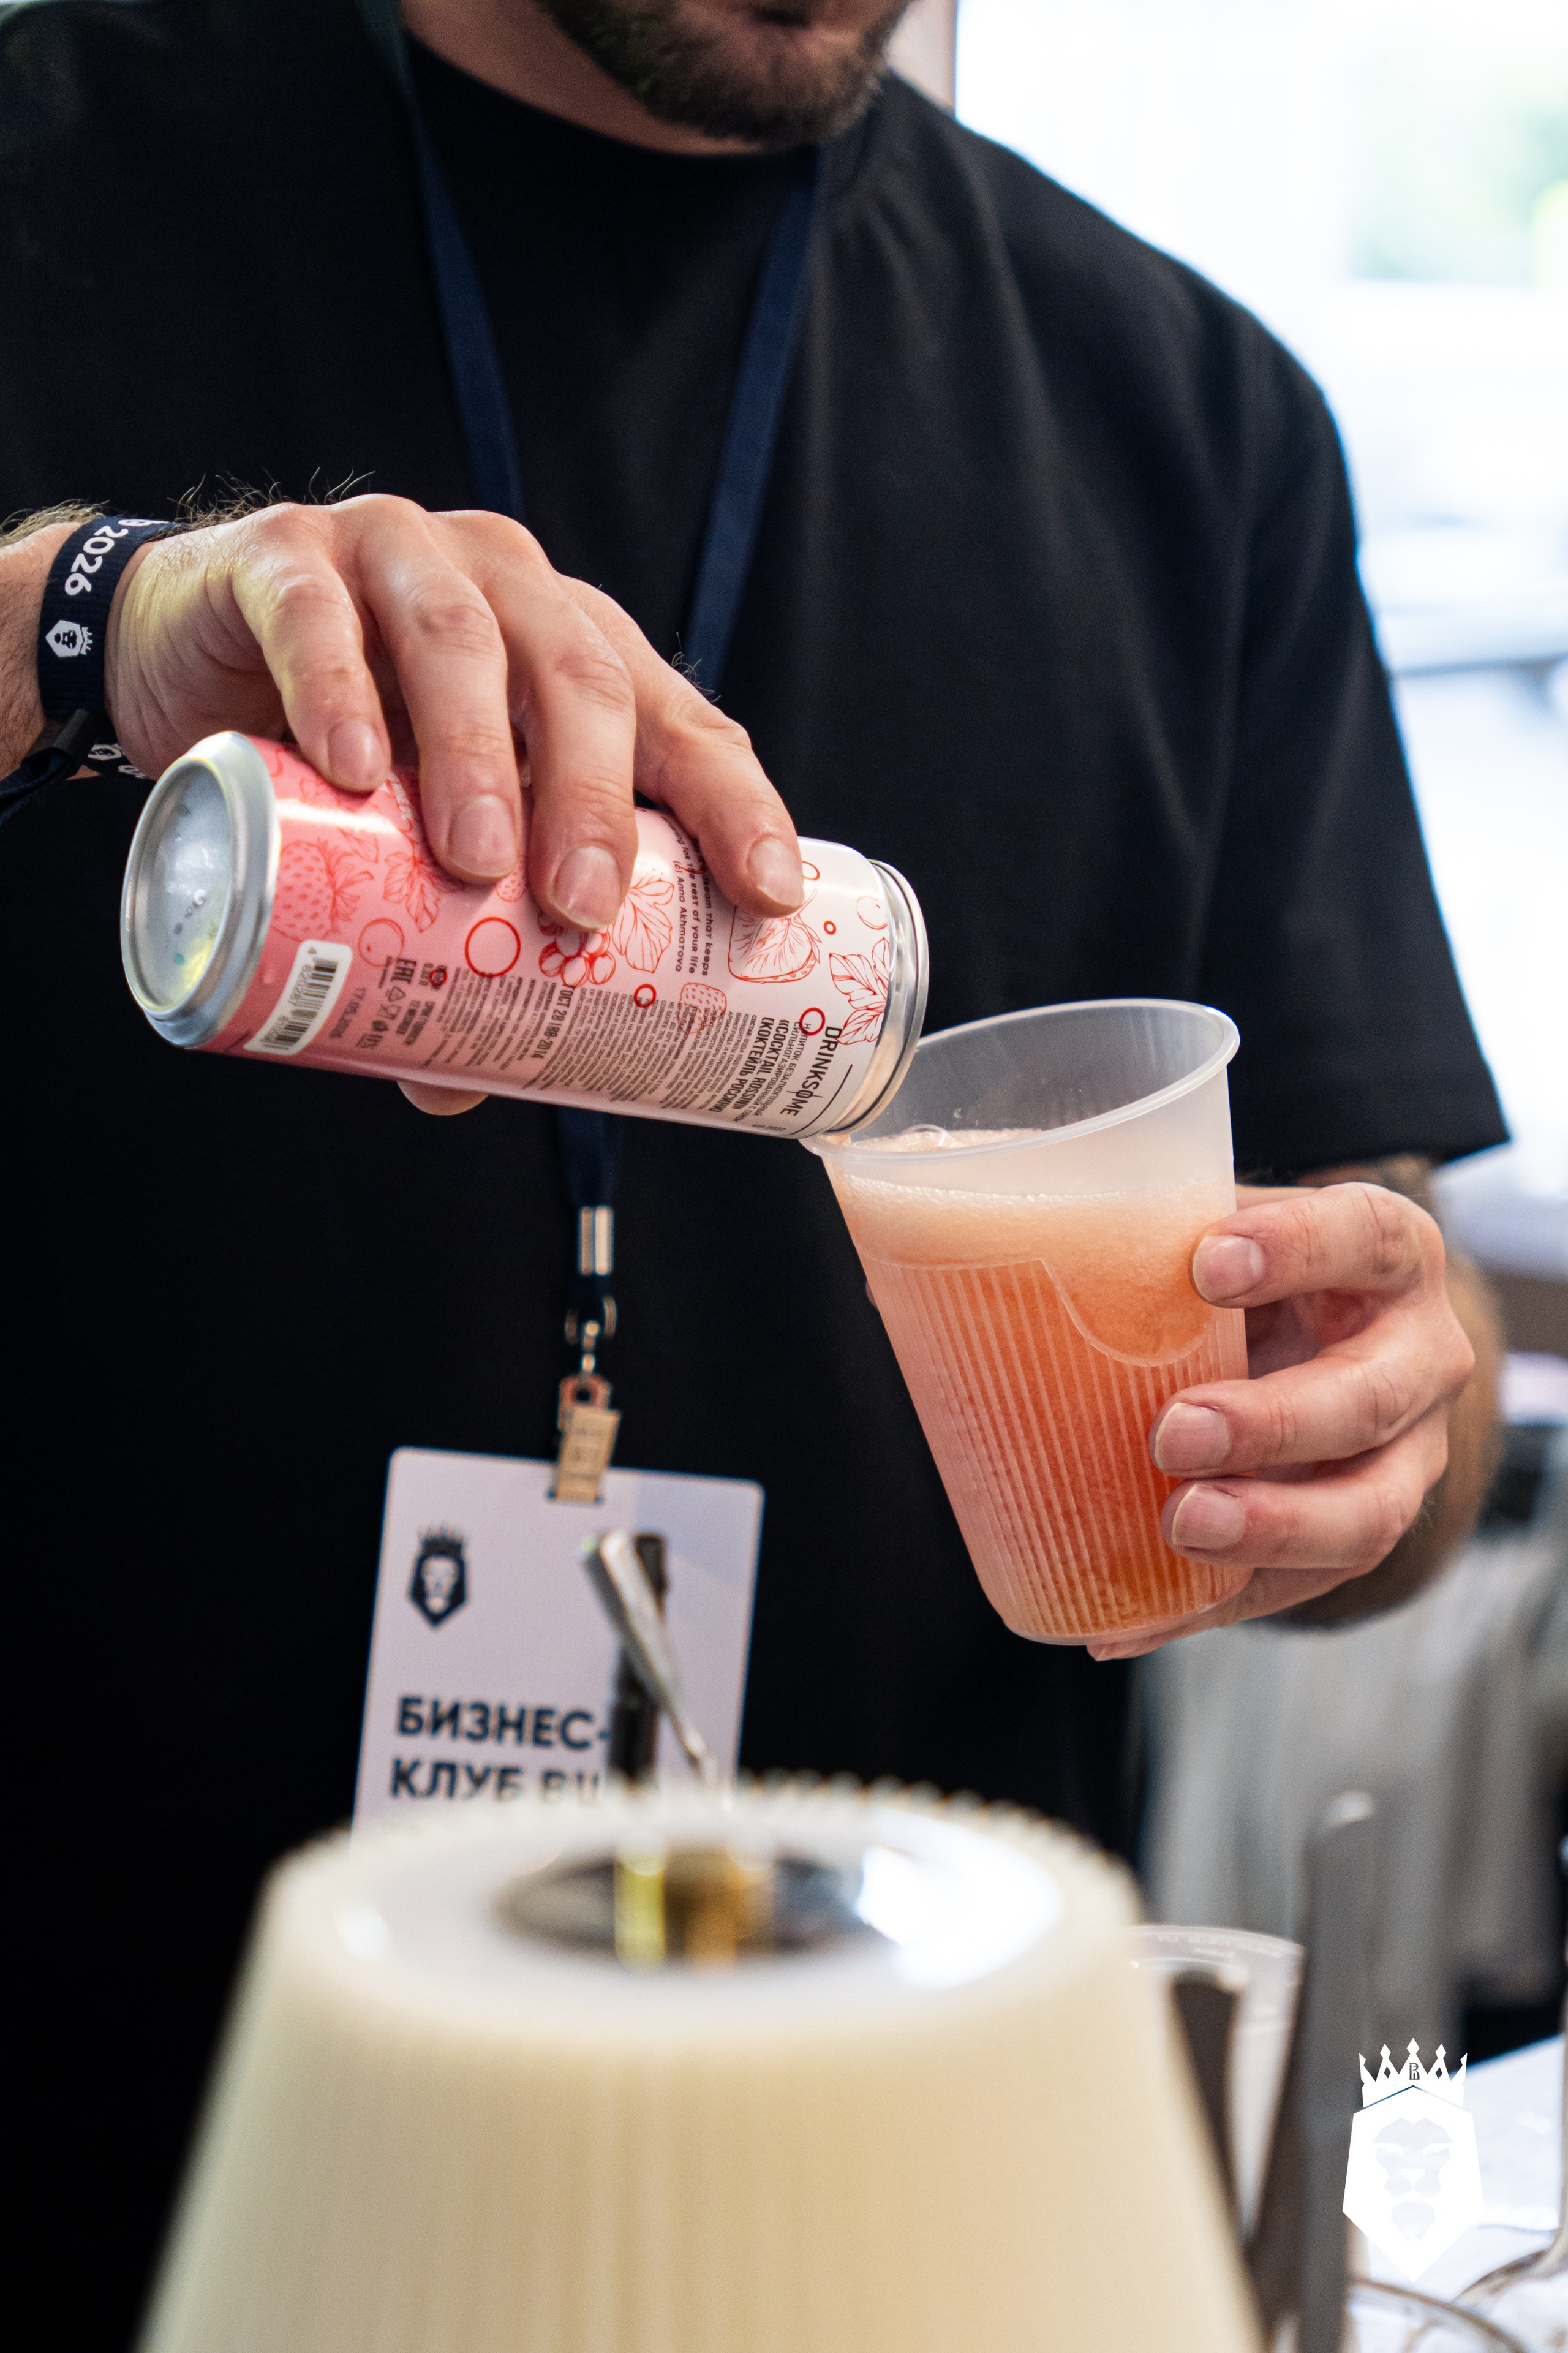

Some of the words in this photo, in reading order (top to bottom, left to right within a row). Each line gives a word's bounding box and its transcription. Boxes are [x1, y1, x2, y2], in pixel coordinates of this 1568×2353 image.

[65, 525, 129, 595] 2026
[676, 876, 686, 902] Anna
[692, 910, 700, 921] of
[688, 956, 698, 973] life
[701, 942, 713, 976] keeps
[396, 1694, 611, 1751] БИЗНЕС-
